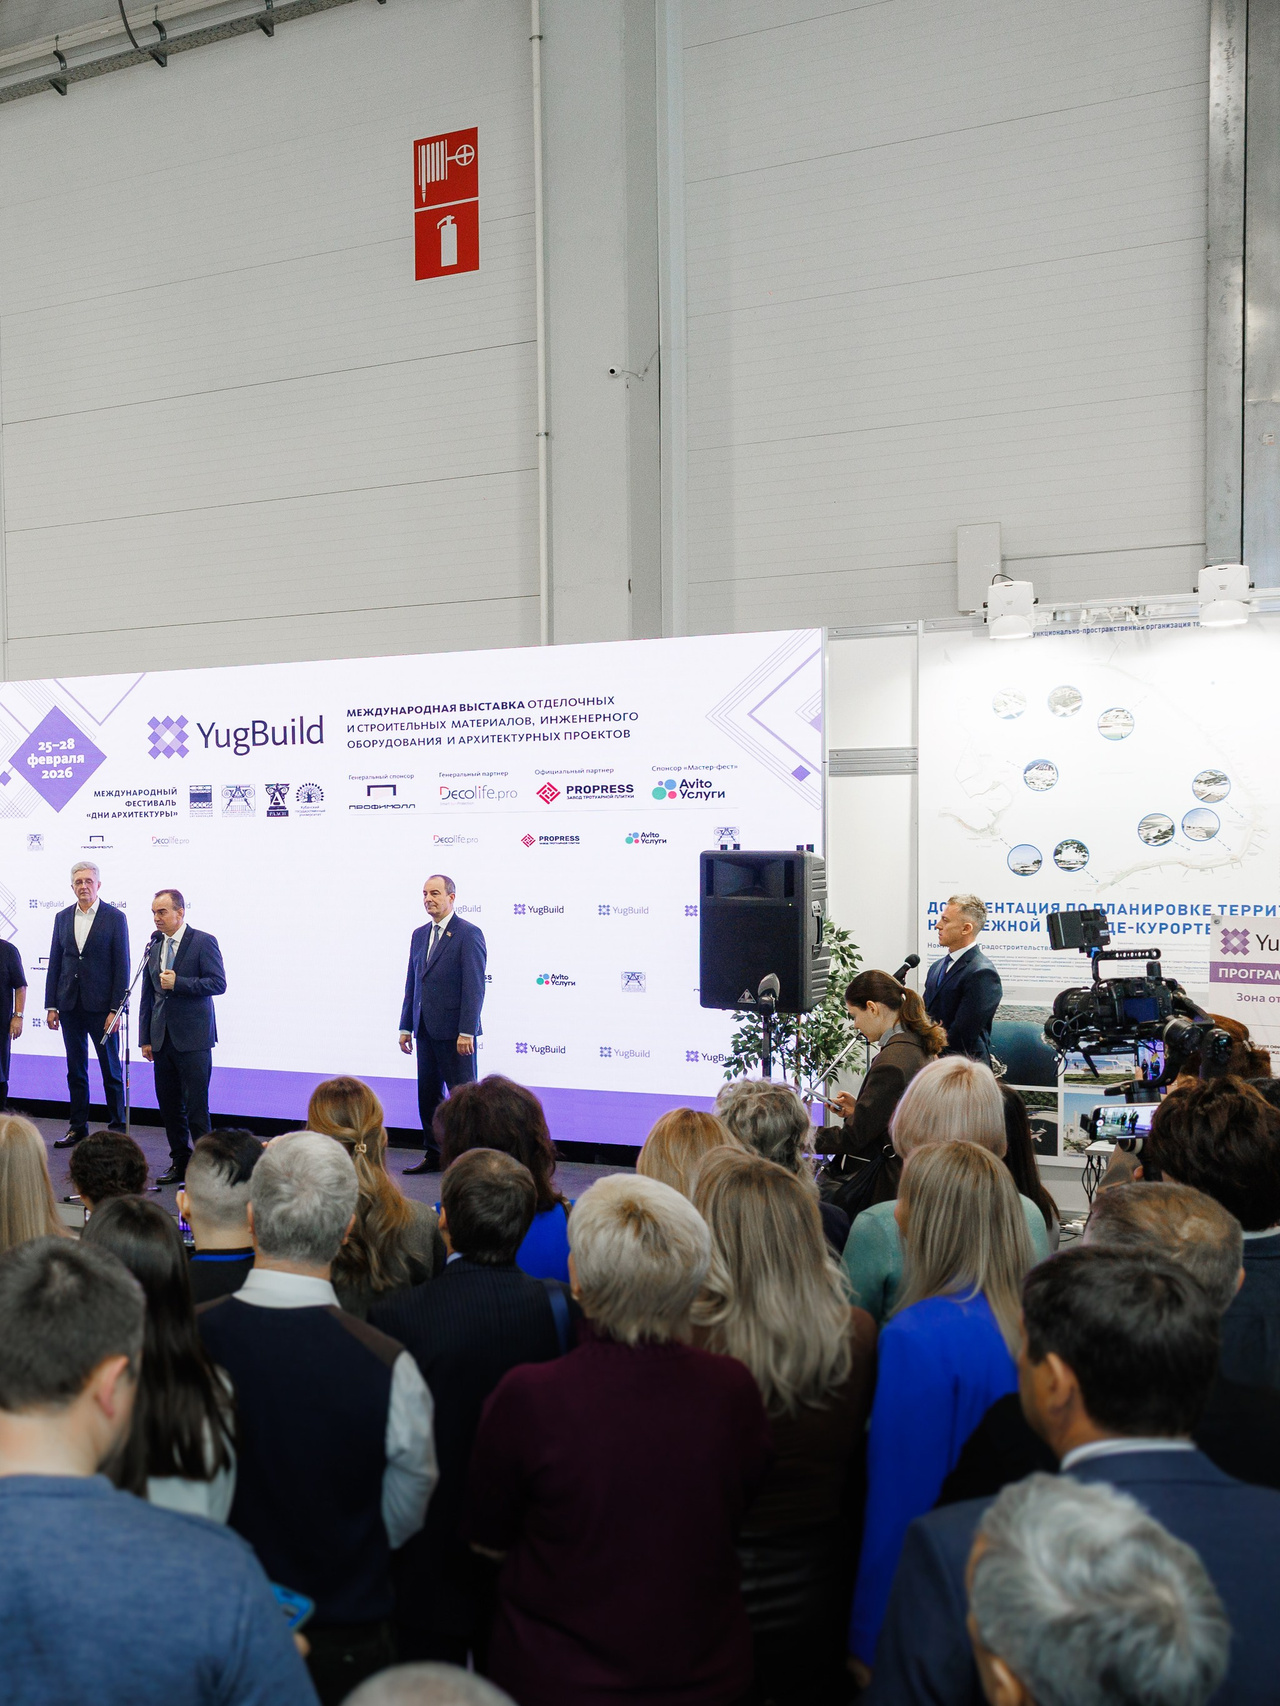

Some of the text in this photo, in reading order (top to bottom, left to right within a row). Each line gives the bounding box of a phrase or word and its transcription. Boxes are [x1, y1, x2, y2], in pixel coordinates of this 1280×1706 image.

[1146, 621, 1192, 632] организация
[347, 696, 615, 717] МЕЖДУНАРОДНАЯ ВЫСТАВКА ОТДЕЛОЧНЫХ
[347, 712, 639, 733] И СТРОИТЕЛЬНЫХ МАТЕРИАЛОВ, ИНЖЕНЕРНОГО
[196, 715, 324, 756] YugBuild
[347, 729, 631, 749] ОБОРУДОВАНИЯ И АРХИТЕКТУРНЫХ ПРОЕКТОВ
[26, 752, 85, 769] февраля
[41, 767, 73, 780] 2026
[534, 767, 615, 776] Официальный партнер
[651, 764, 738, 773] Спонсор «Мастер-фест»
[566, 784, 634, 794] PROPRESS
[679, 778, 713, 789] Avito
[94, 786, 178, 798] МЕЖДУНАРОДНЫЙ
[679, 789, 726, 802] Услуги
[125, 799, 176, 808] ФЕСТИВАЛЬ
[86, 810, 179, 820] «ДНИ АРХИТЕКТУРЫ»
[39, 900, 65, 911] YugBuild
[527, 905, 565, 916] YugBuild
[612, 906, 649, 916] YugBuild
[927, 902, 1060, 916] ДОЕНТАЦИЯ
[1094, 903, 1211, 916] ПЛАНИРОВКЕ
[1218, 904, 1280, 917] ТЕРРИ
[1236, 993, 1266, 1003] Зона
[530, 1045, 566, 1055] YugBuild
[614, 1049, 651, 1059] YugBuild
